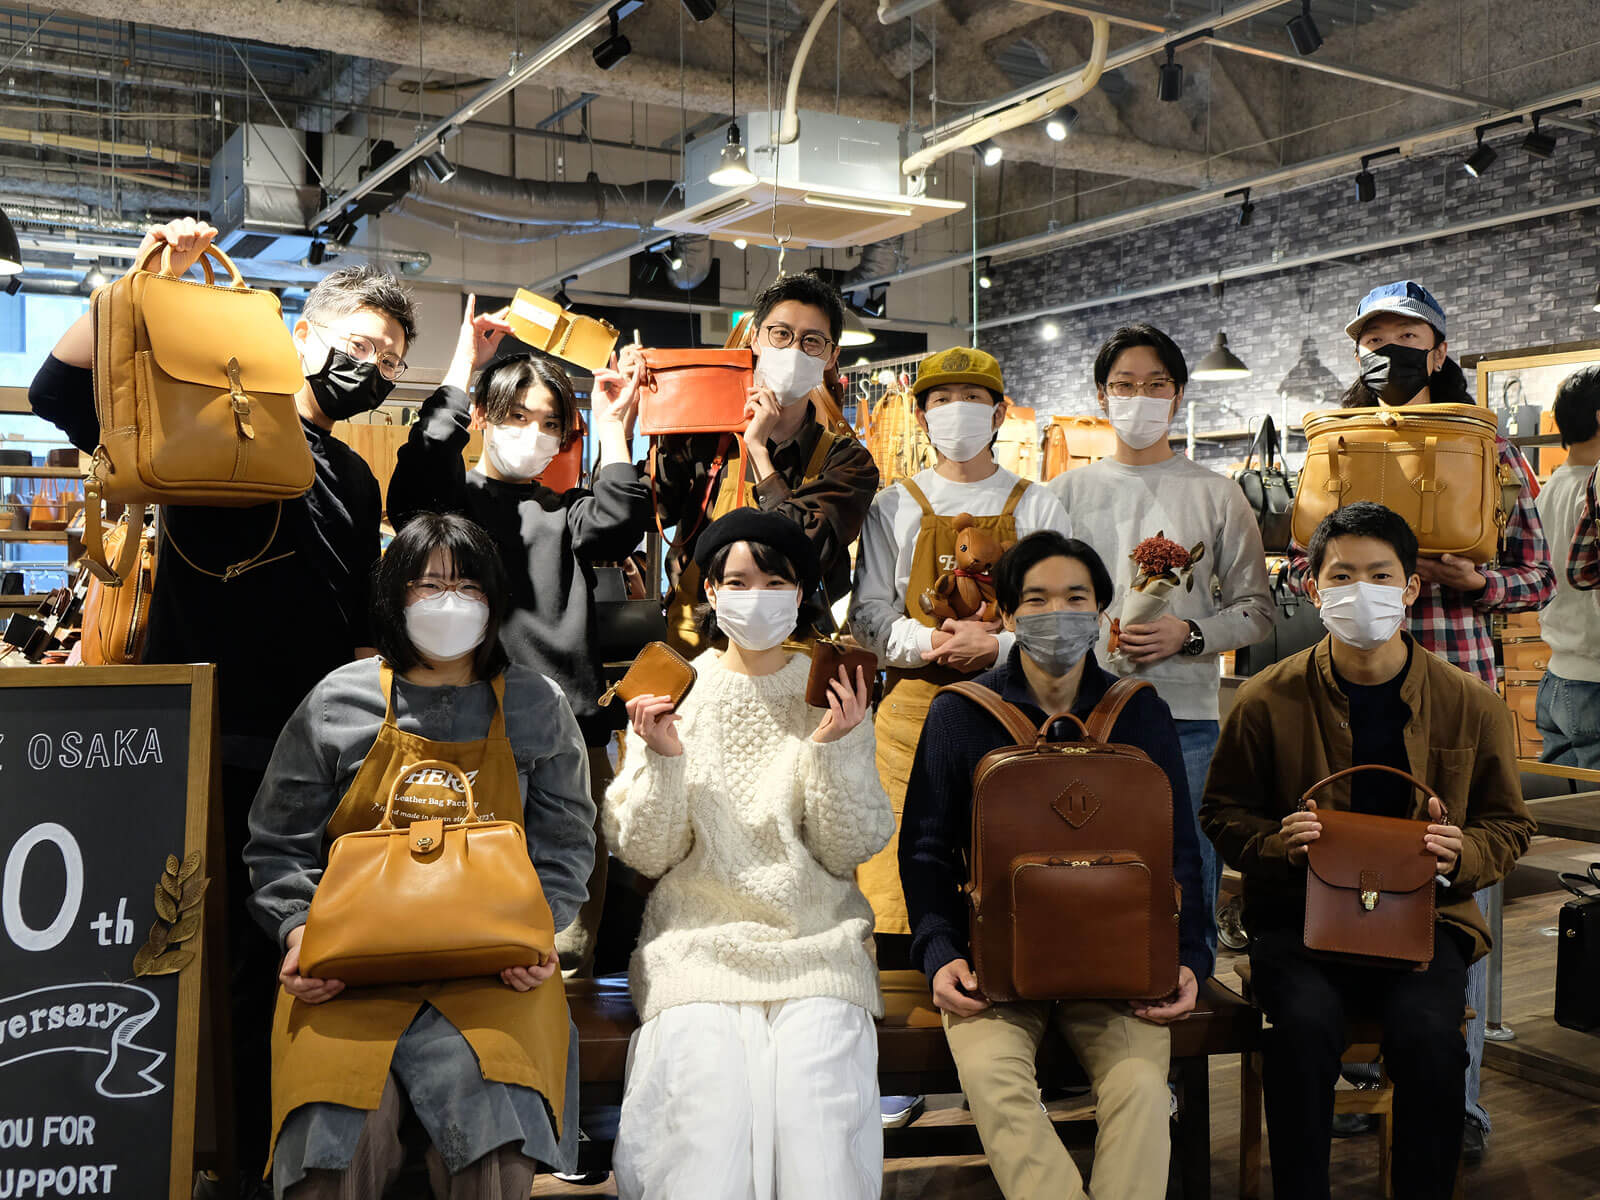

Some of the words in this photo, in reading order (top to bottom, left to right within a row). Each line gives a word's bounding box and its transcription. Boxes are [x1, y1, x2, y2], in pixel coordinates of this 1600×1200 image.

[28, 727, 163, 769] OSAKA
[394, 793, 426, 804] Leather
[428, 797, 445, 807] Bag
[446, 799, 479, 808] Facty
[0, 1118, 34, 1148] OU
[42, 1115, 96, 1148] FOR
